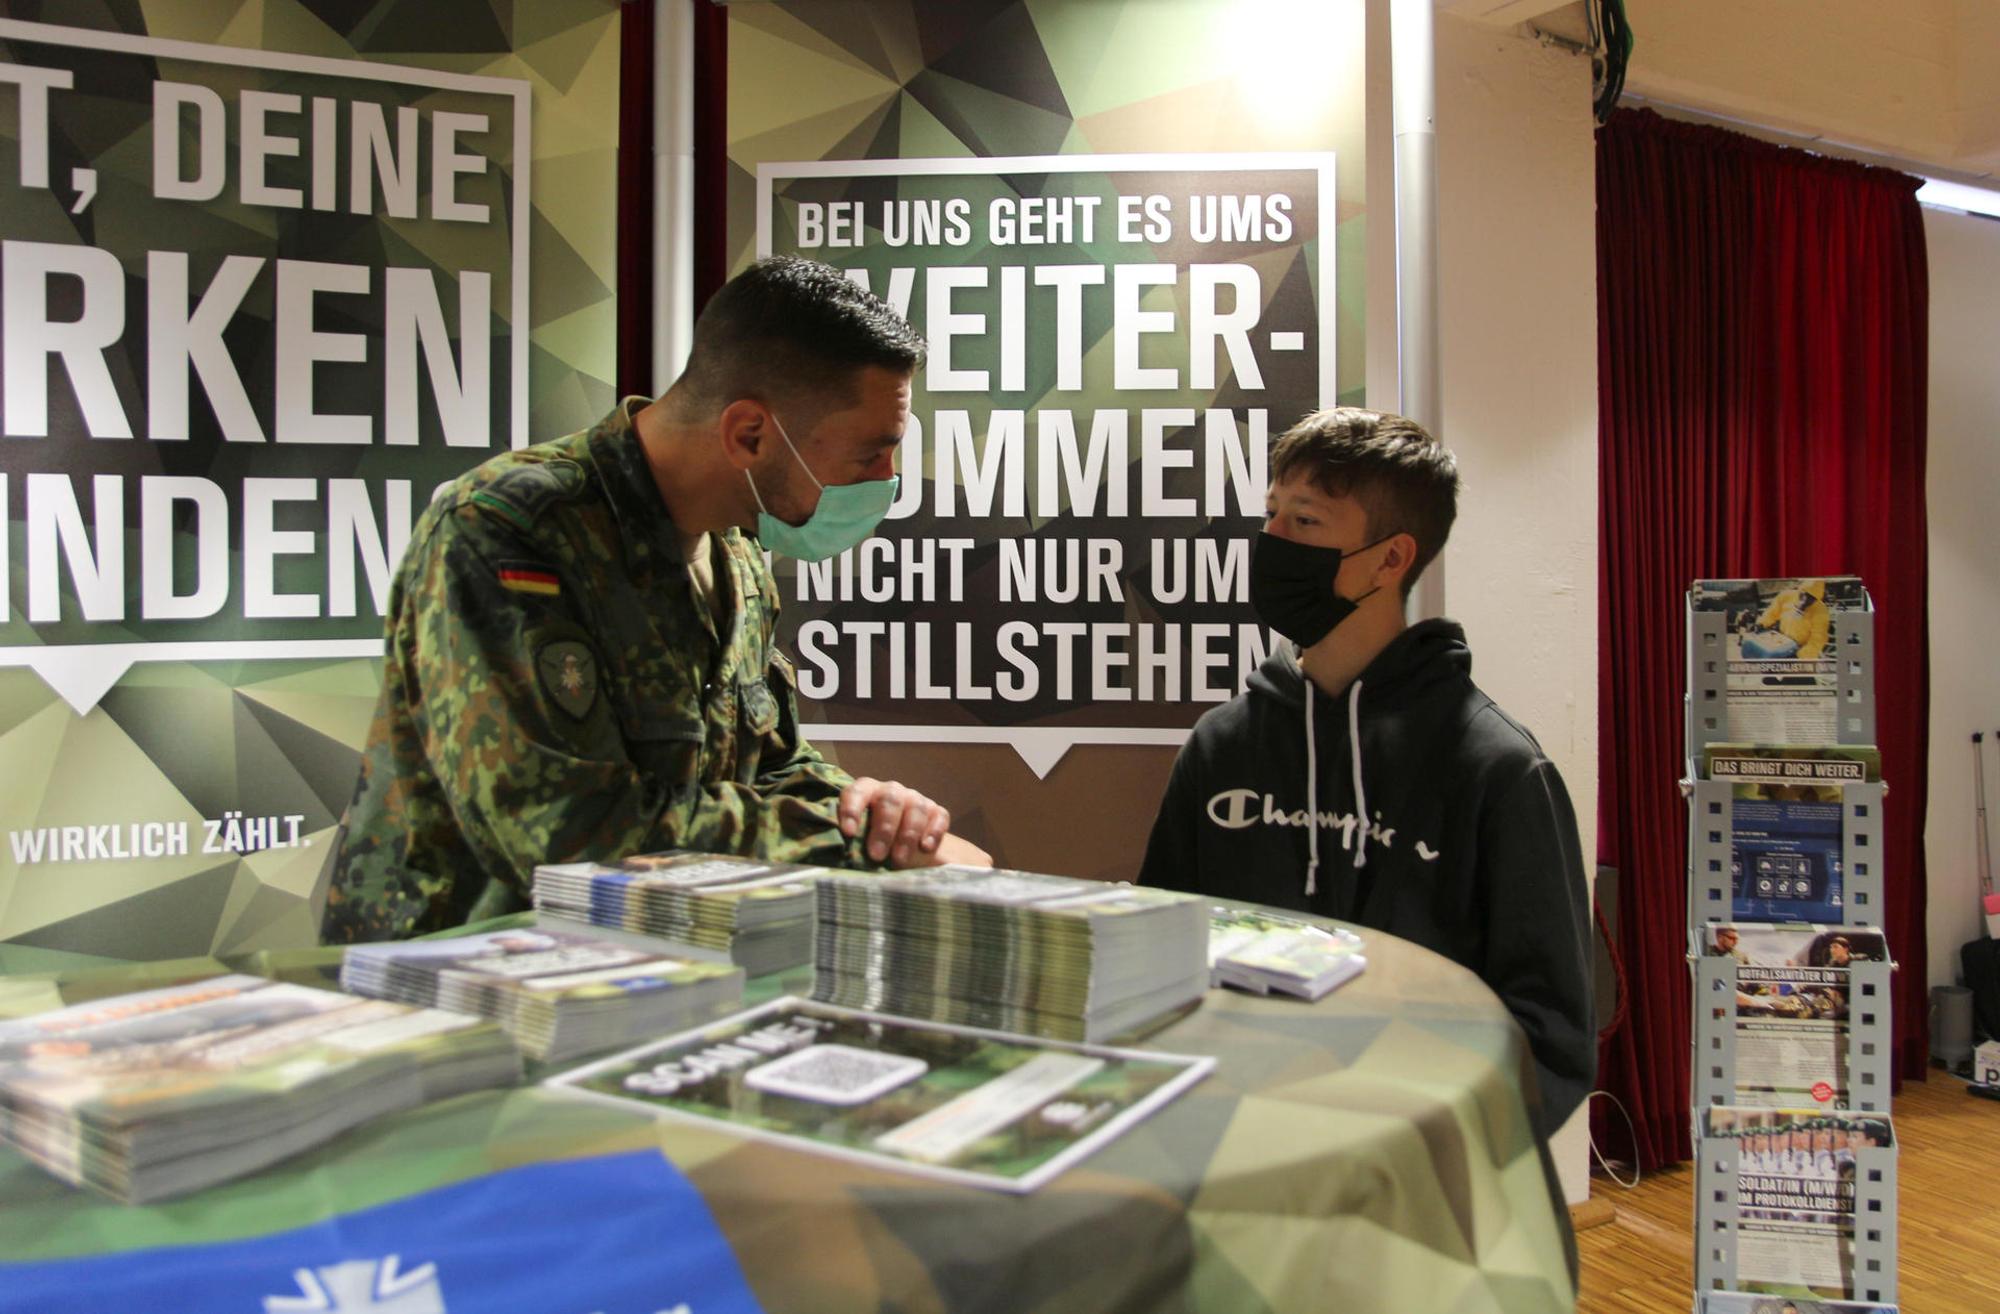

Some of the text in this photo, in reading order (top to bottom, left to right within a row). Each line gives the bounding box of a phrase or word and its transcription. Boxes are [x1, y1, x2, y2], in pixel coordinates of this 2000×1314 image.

[153, 79, 491, 223] DEINE
[798, 193, 1293, 248] BEI UNS GEHT ES UMS
[796, 537, 1250, 603] NICHT NUR UM
[1714, 760, 1861, 778] DAS BRINGT DICH WEITER.
[9, 810, 312, 865] WIRKLICH ZÄHLT.
